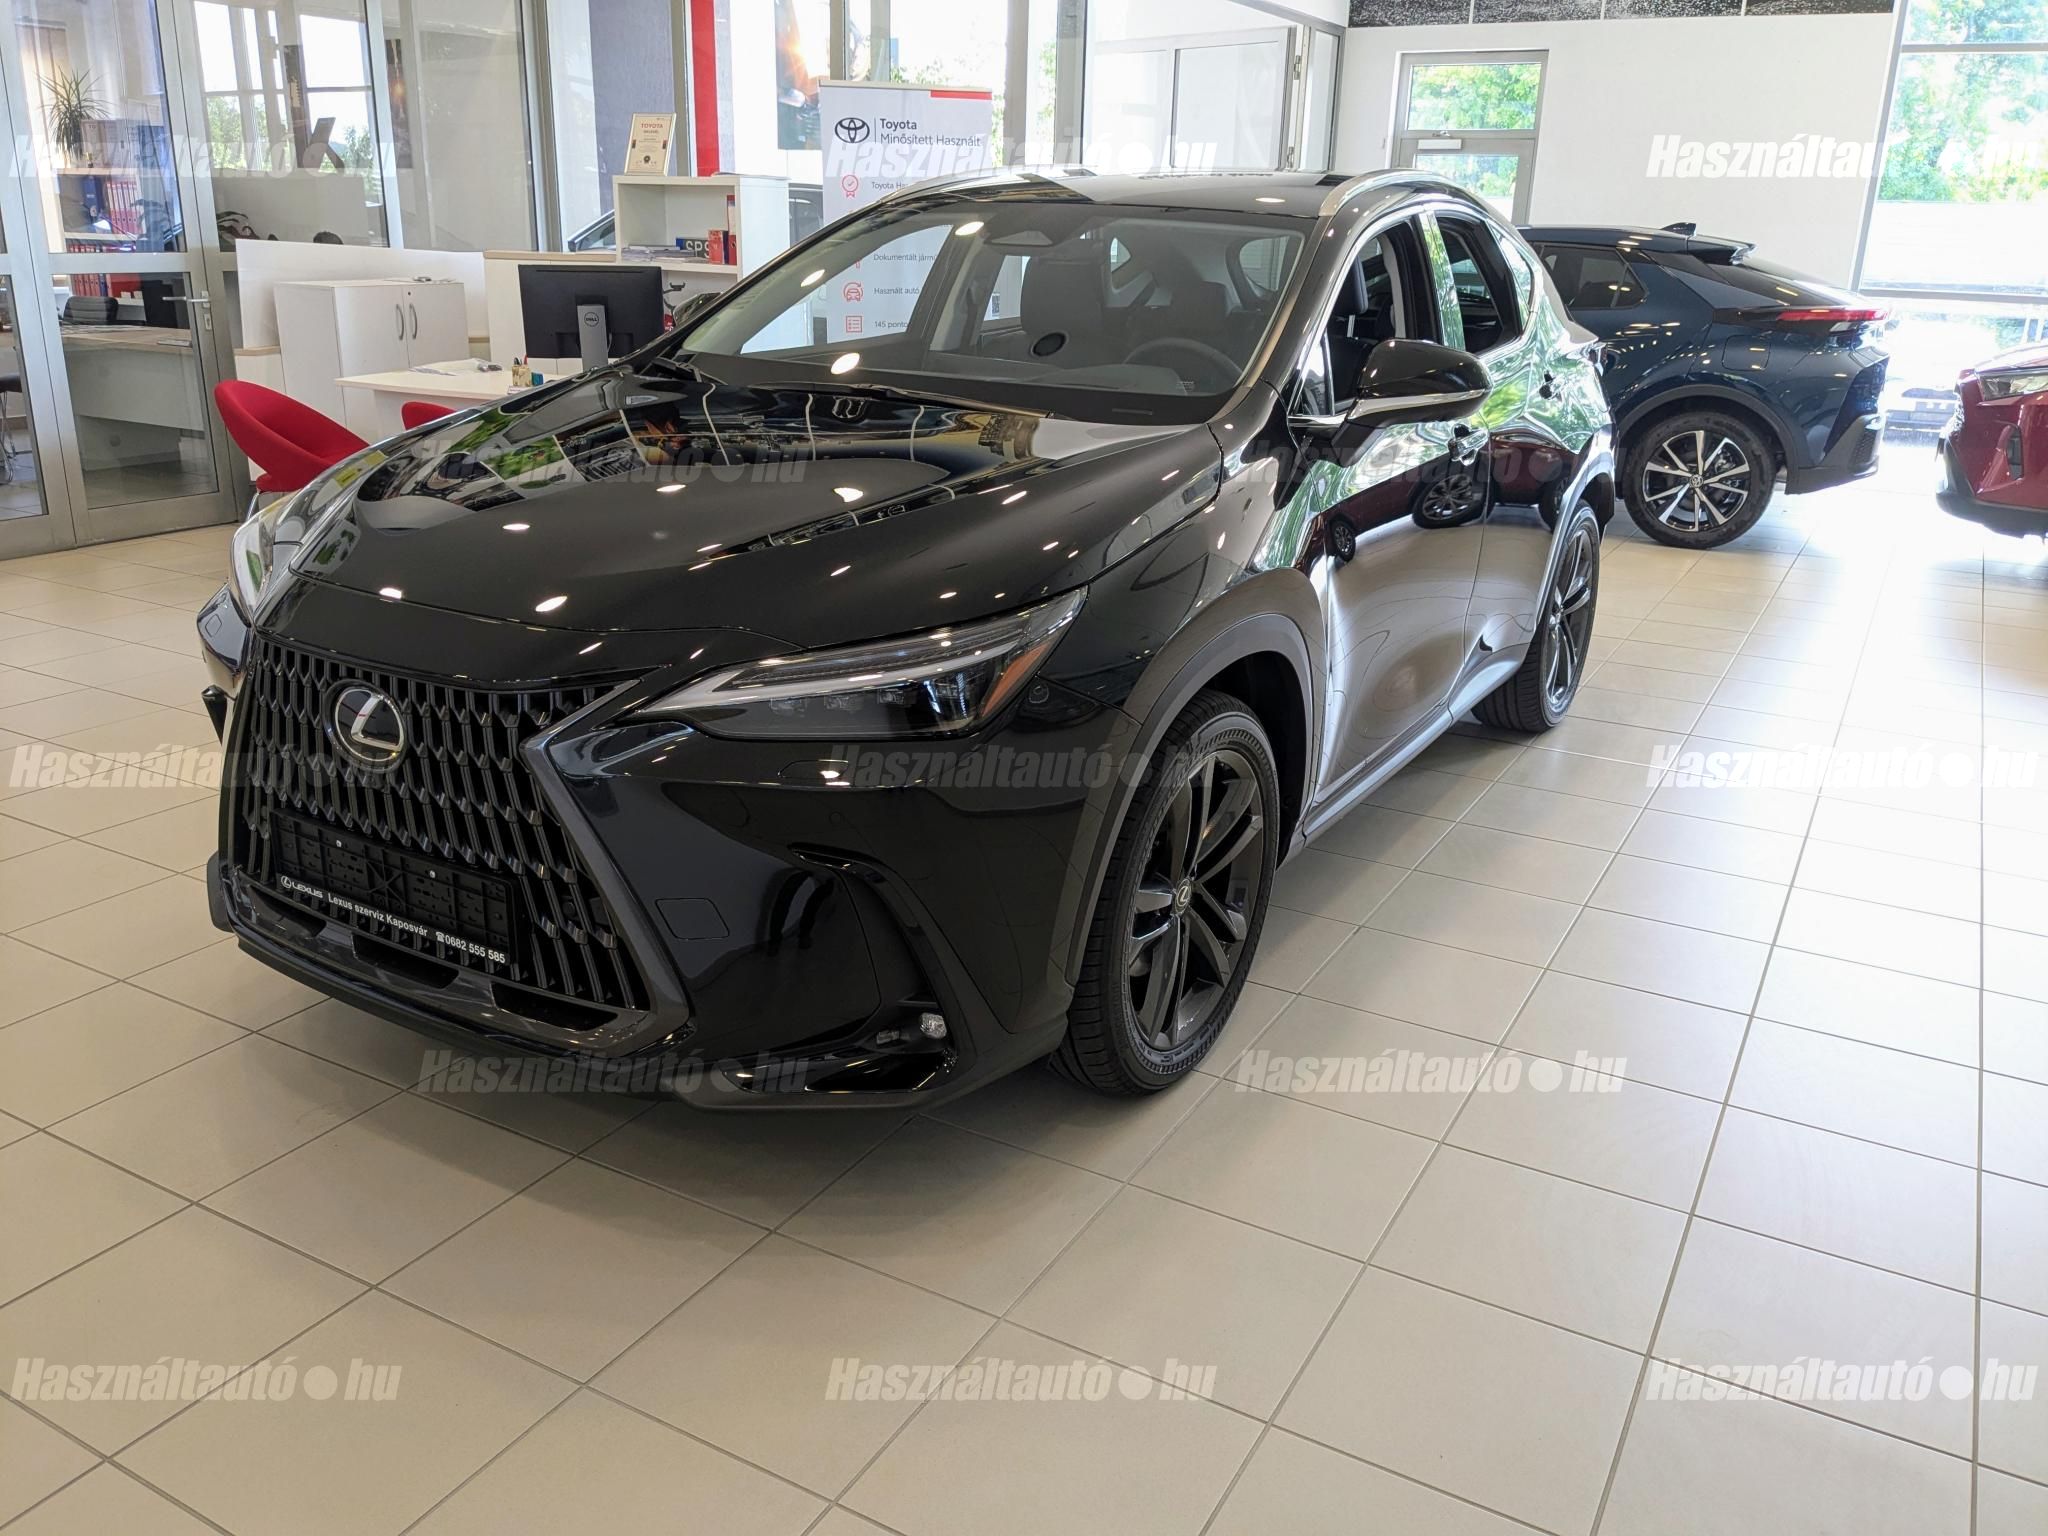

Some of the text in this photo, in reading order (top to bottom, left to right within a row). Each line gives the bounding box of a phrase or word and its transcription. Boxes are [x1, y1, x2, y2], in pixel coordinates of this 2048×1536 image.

[880, 118, 917, 132] Toyota
[880, 132, 981, 147] Minősített Használt
[871, 181, 894, 191] Toyota
[873, 287, 920, 295] Használt autó
[874, 320, 887, 328] 145
[292, 881, 323, 898] LEXUS
[328, 892, 353, 910] Lexus
[354, 904, 385, 922] szerviz
[386, 913, 428, 937] Kaposvár
[445, 934, 467, 951] 0682
[468, 943, 486, 957] 555
[488, 949, 506, 964] 585
